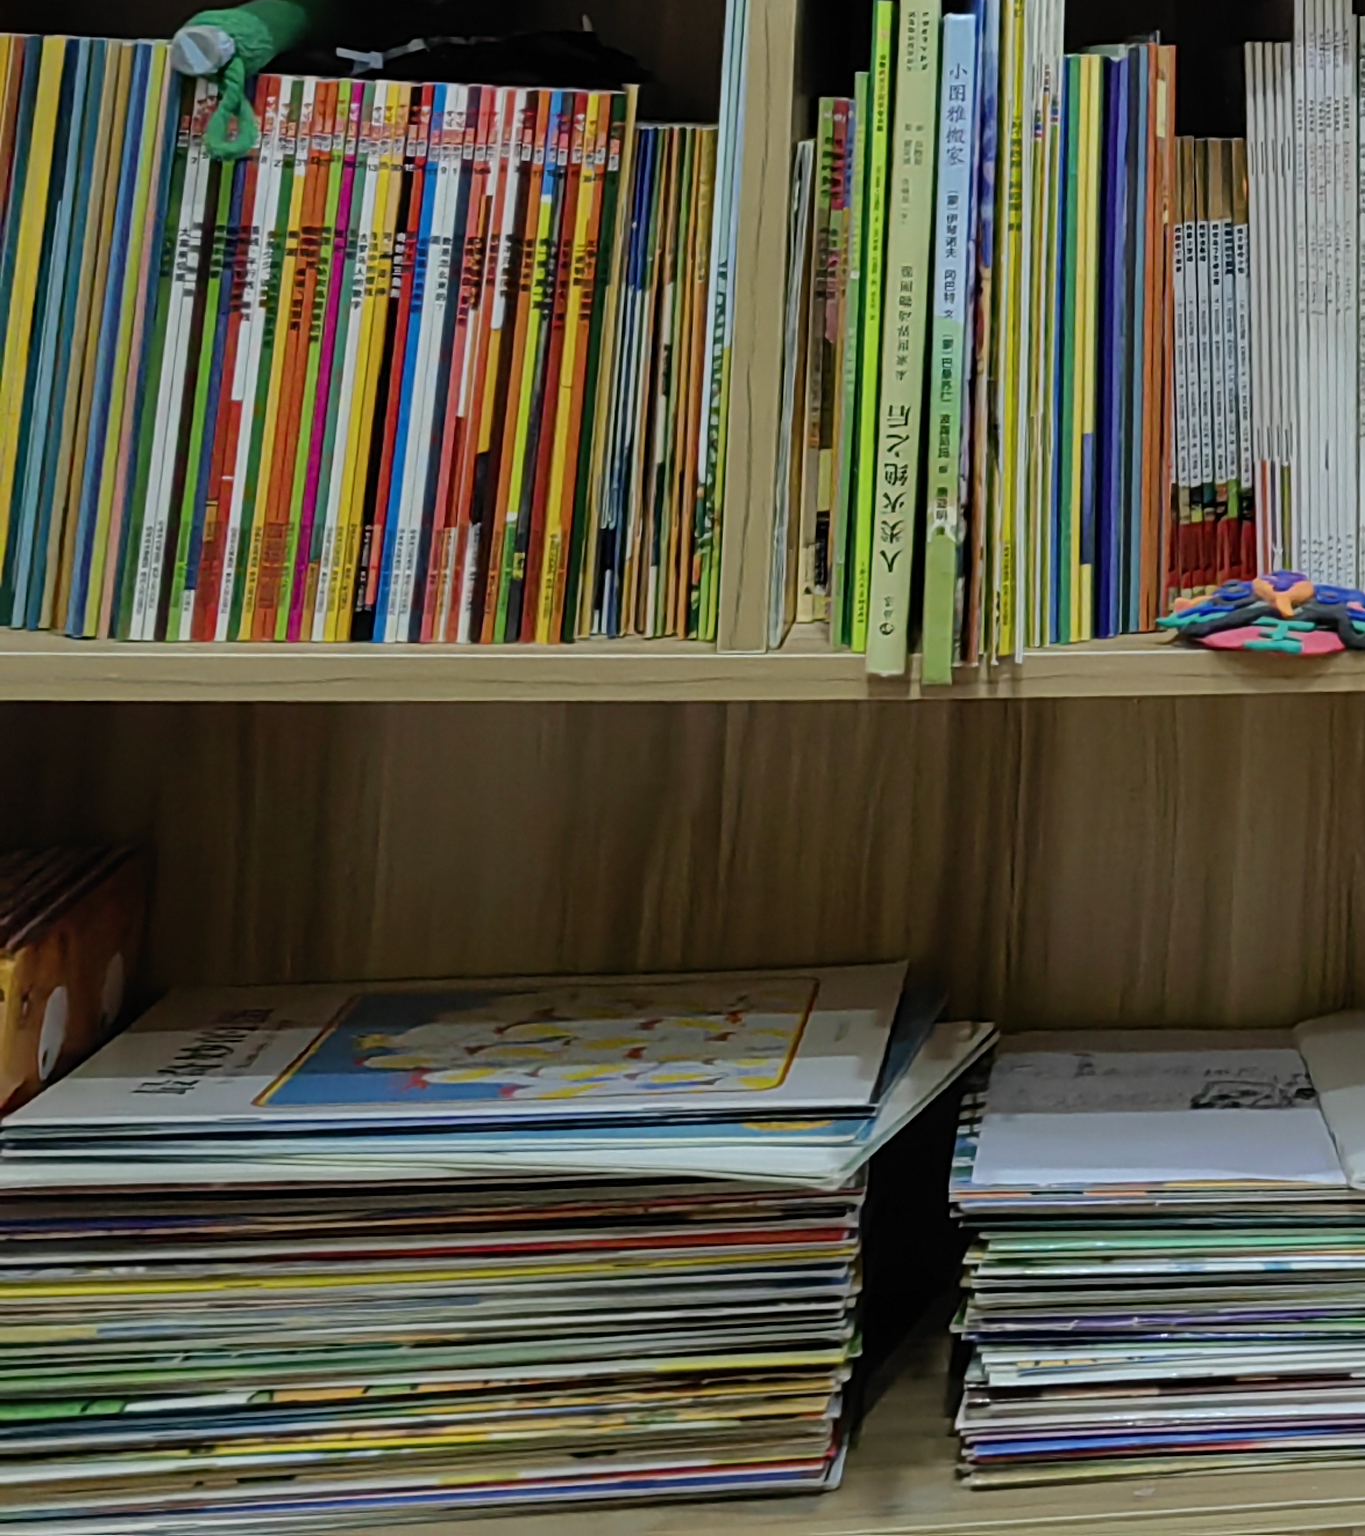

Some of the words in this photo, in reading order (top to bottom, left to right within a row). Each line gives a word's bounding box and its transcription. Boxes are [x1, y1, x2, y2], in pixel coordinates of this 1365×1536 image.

[946, 63, 967, 167] 小图雅搬家
[879, 405, 912, 575] 人类灭绝之后
